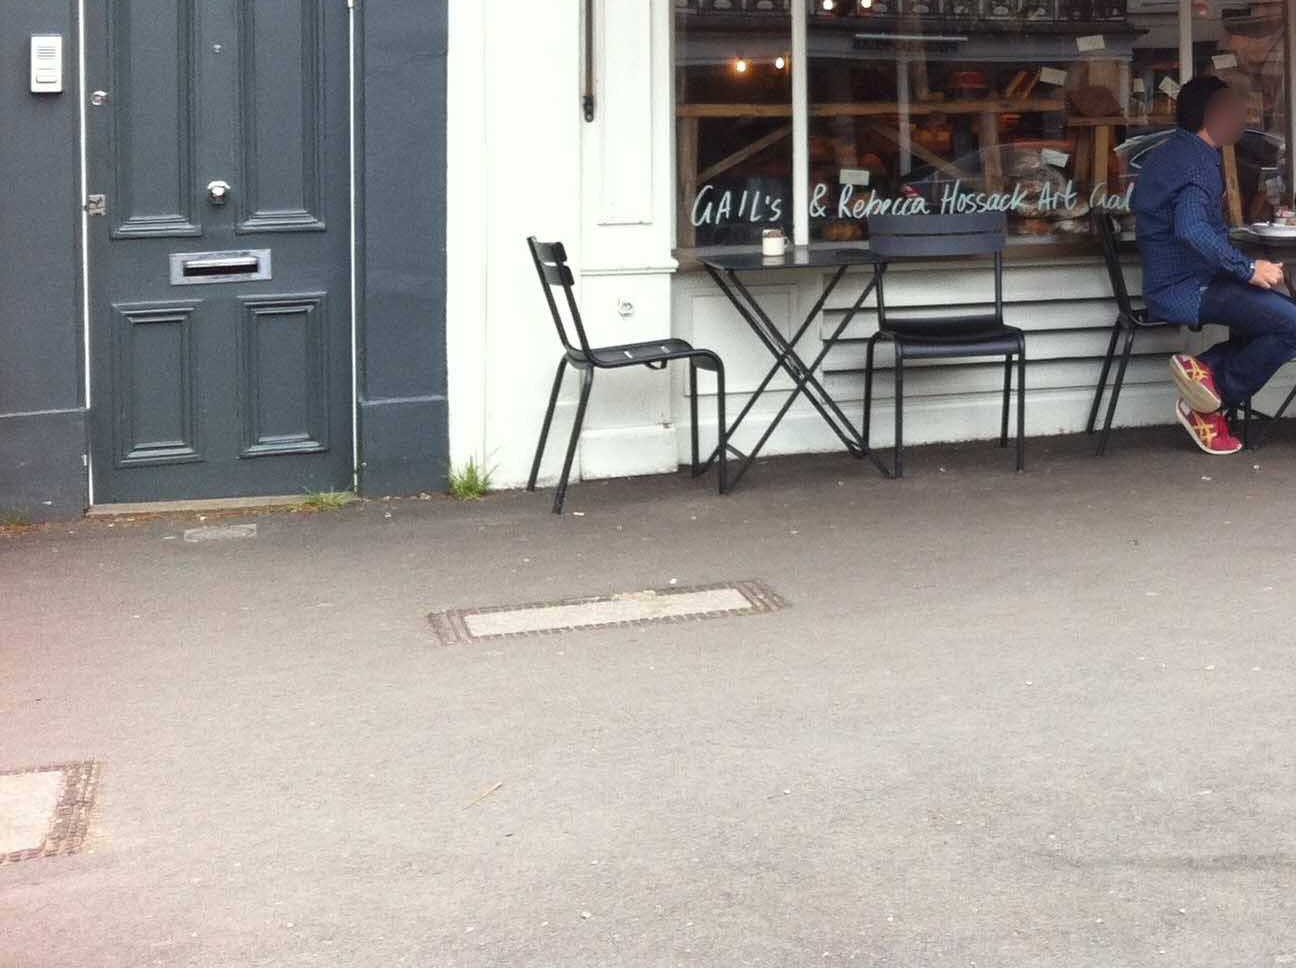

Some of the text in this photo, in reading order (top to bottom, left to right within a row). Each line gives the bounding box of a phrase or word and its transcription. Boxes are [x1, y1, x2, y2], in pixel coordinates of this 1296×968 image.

[691, 185, 782, 226] GAIL's
[809, 183, 826, 218] &
[838, 184, 930, 219] Rebecca
[940, 179, 1028, 215] Hossack
[1037, 180, 1077, 210] Art
